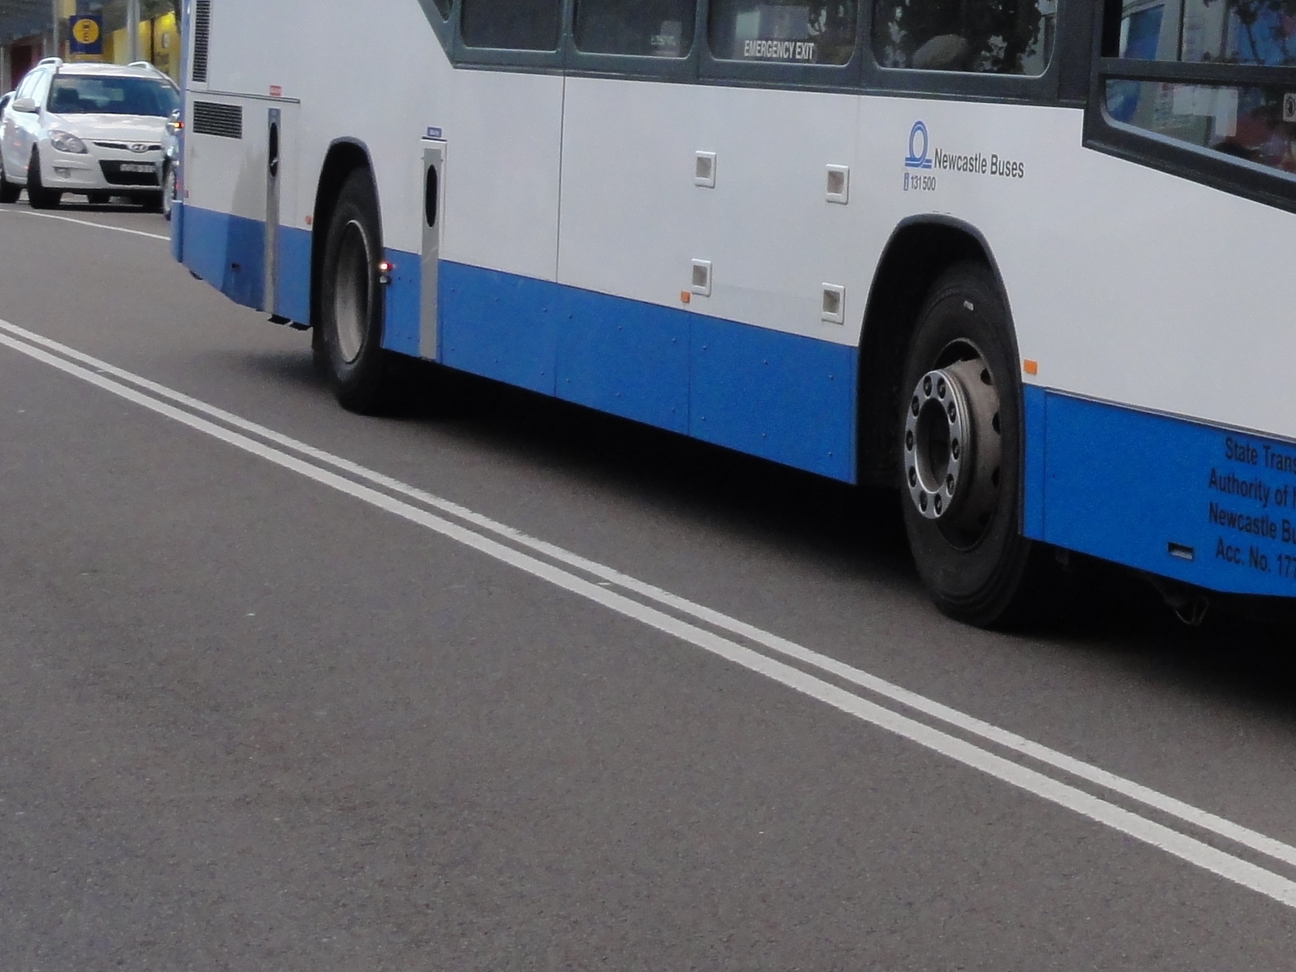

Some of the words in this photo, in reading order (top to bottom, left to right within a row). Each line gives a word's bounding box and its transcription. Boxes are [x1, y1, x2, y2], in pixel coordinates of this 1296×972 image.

[744, 40, 795, 59] EMERGENCY
[795, 41, 815, 60] EXIT
[934, 148, 988, 175] Newcastle
[990, 154, 1025, 179] Buses
[1225, 437, 1258, 465] State
[1208, 468, 1270, 508] Authority
[1275, 484, 1288, 508] of
[1209, 501, 1277, 539] Newcastle
[1215, 538, 1244, 565] Acc.
[1249, 546, 1272, 573] No.
